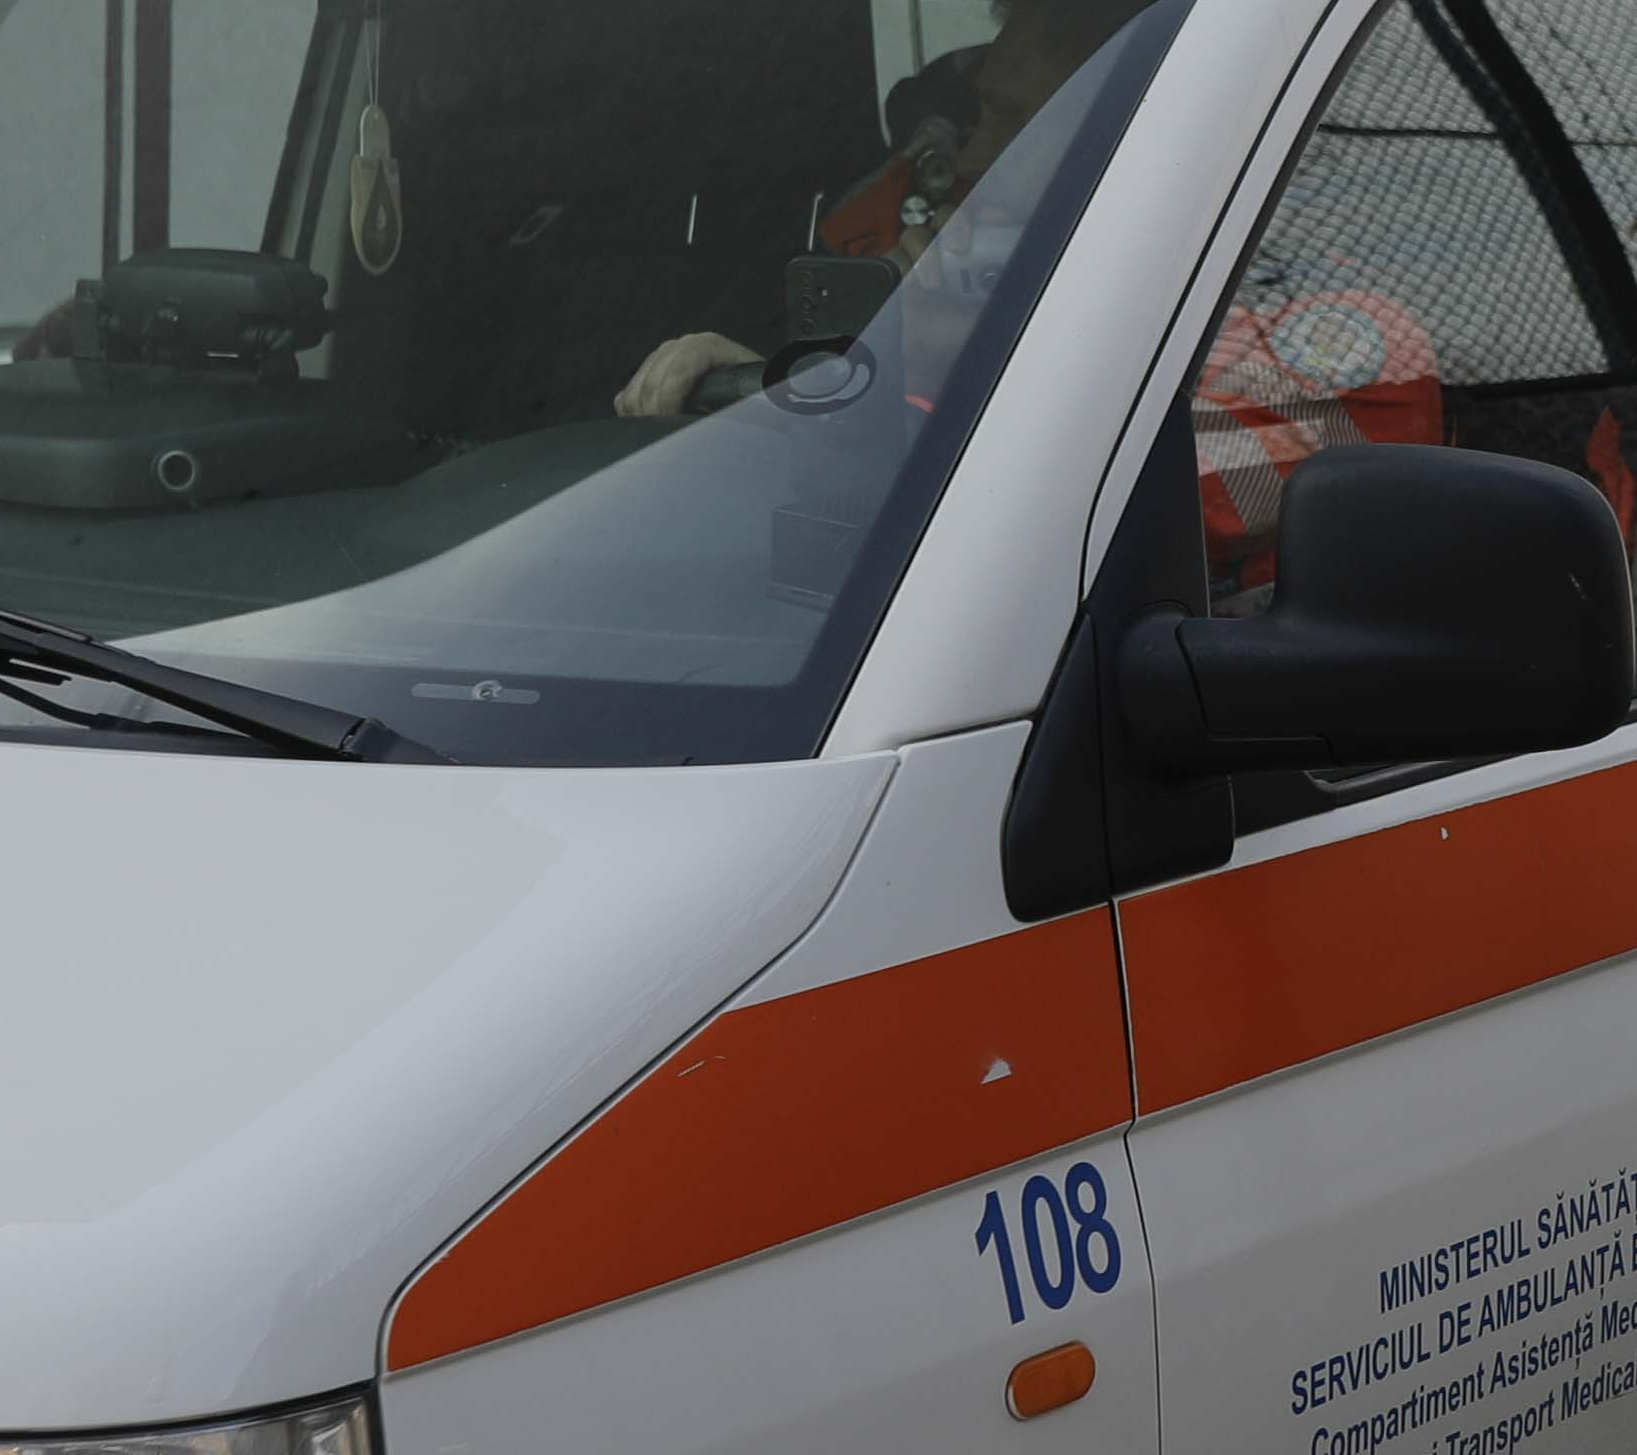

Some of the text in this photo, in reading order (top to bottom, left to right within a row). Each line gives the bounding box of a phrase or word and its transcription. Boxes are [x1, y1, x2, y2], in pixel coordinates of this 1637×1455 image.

[974, 1160, 1123, 1327] 108
[1379, 1219, 1531, 1314] MINISTERUL
[1291, 1322, 1431, 1415] SERVICIUL
[1439, 1302, 1472, 1354] DE
